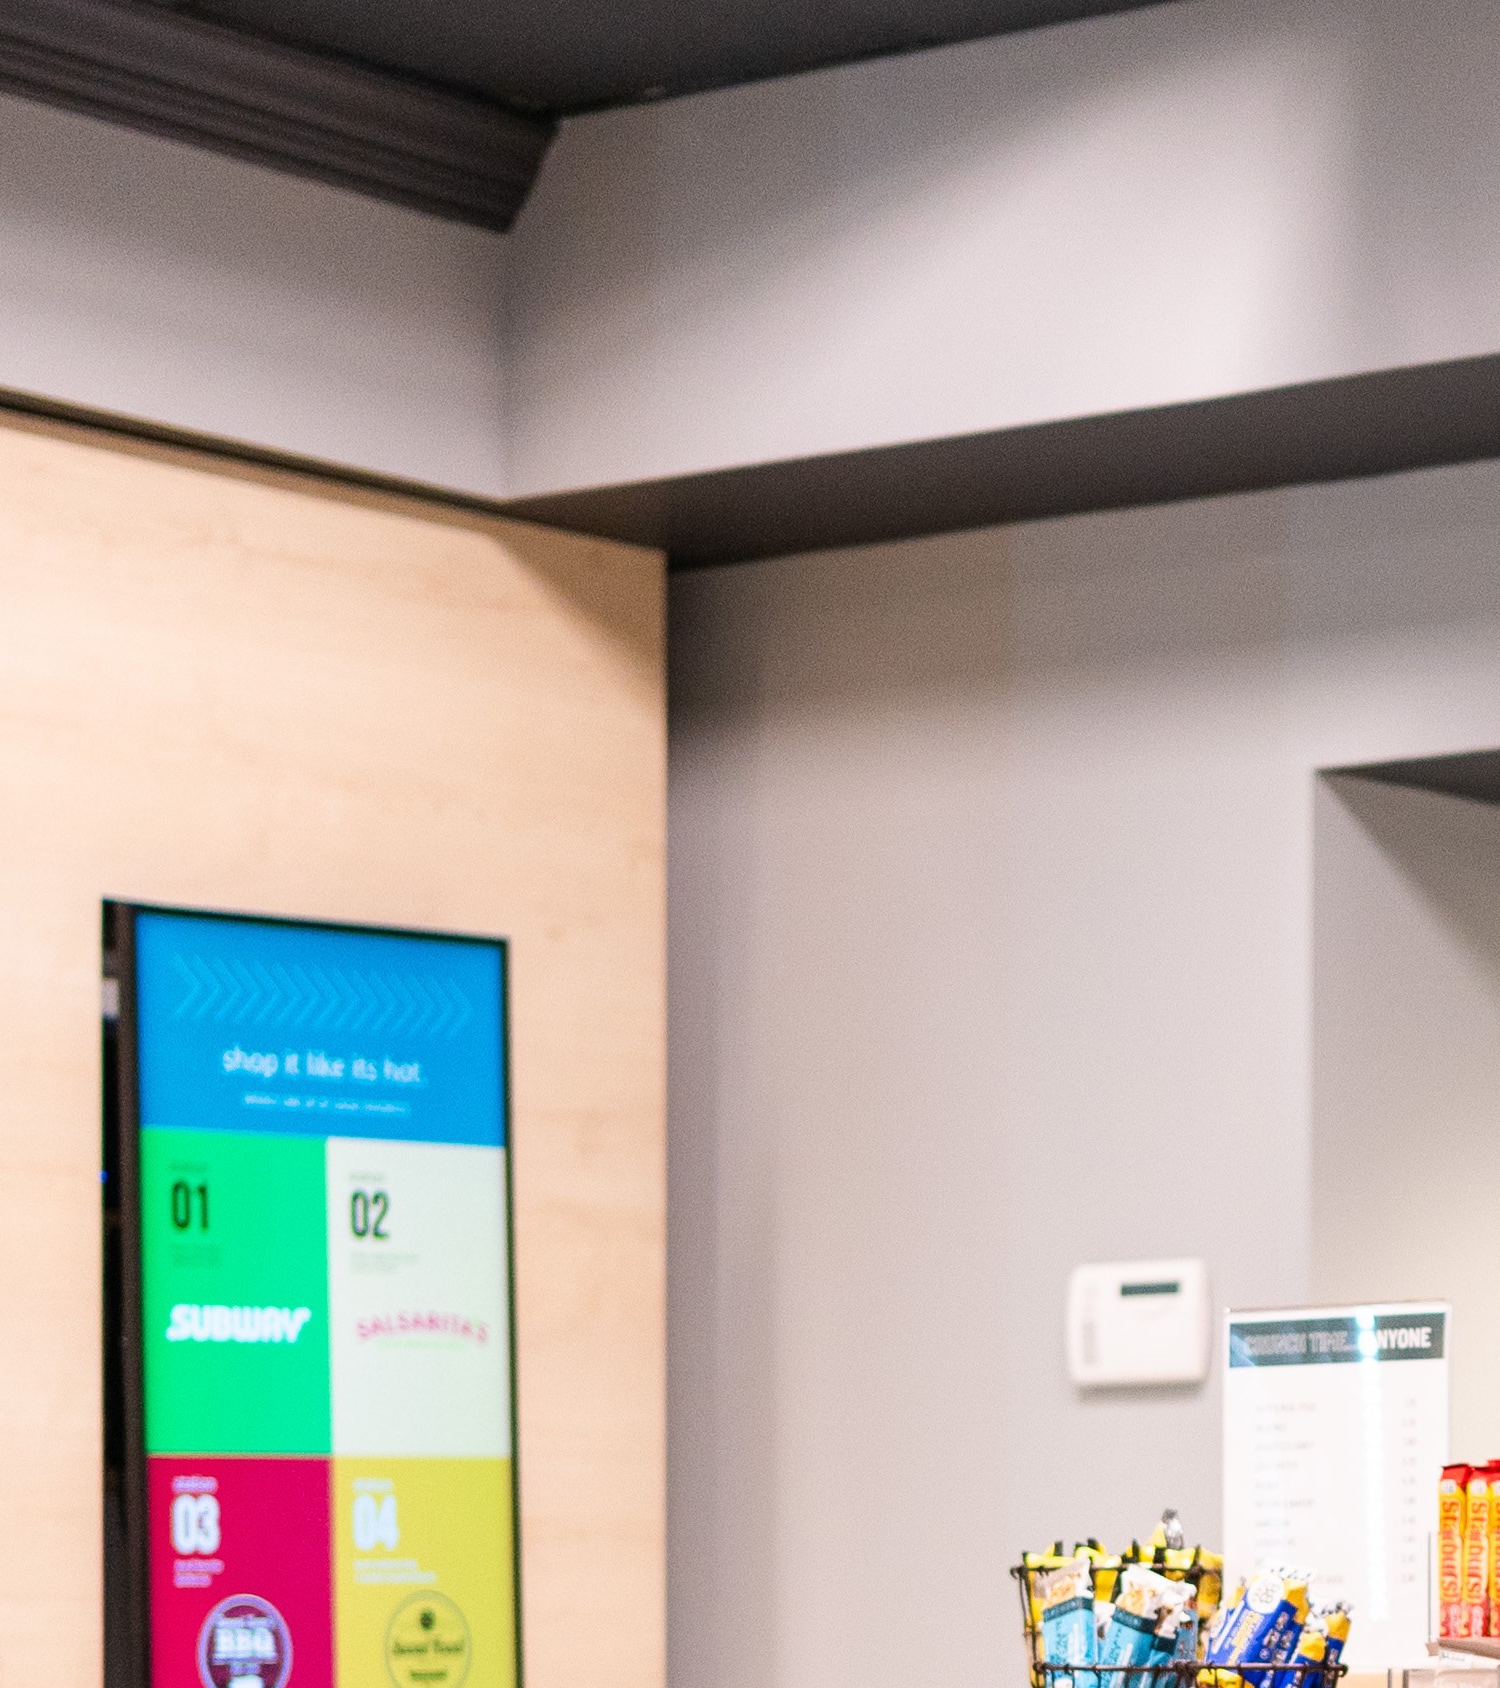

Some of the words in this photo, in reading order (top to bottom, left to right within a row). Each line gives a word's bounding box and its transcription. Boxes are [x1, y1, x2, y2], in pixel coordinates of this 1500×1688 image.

[223, 1044, 278, 1078] shop
[284, 1050, 299, 1075] it
[306, 1049, 344, 1077] like
[384, 1055, 420, 1082] hot
[170, 1181, 209, 1231] 01
[350, 1189, 390, 1239] 02
[166, 1304, 311, 1343] SUBWAY
[1370, 1326, 1432, 1350] NYONE
[172, 1494, 220, 1554] 03
[353, 1494, 399, 1550] 04
